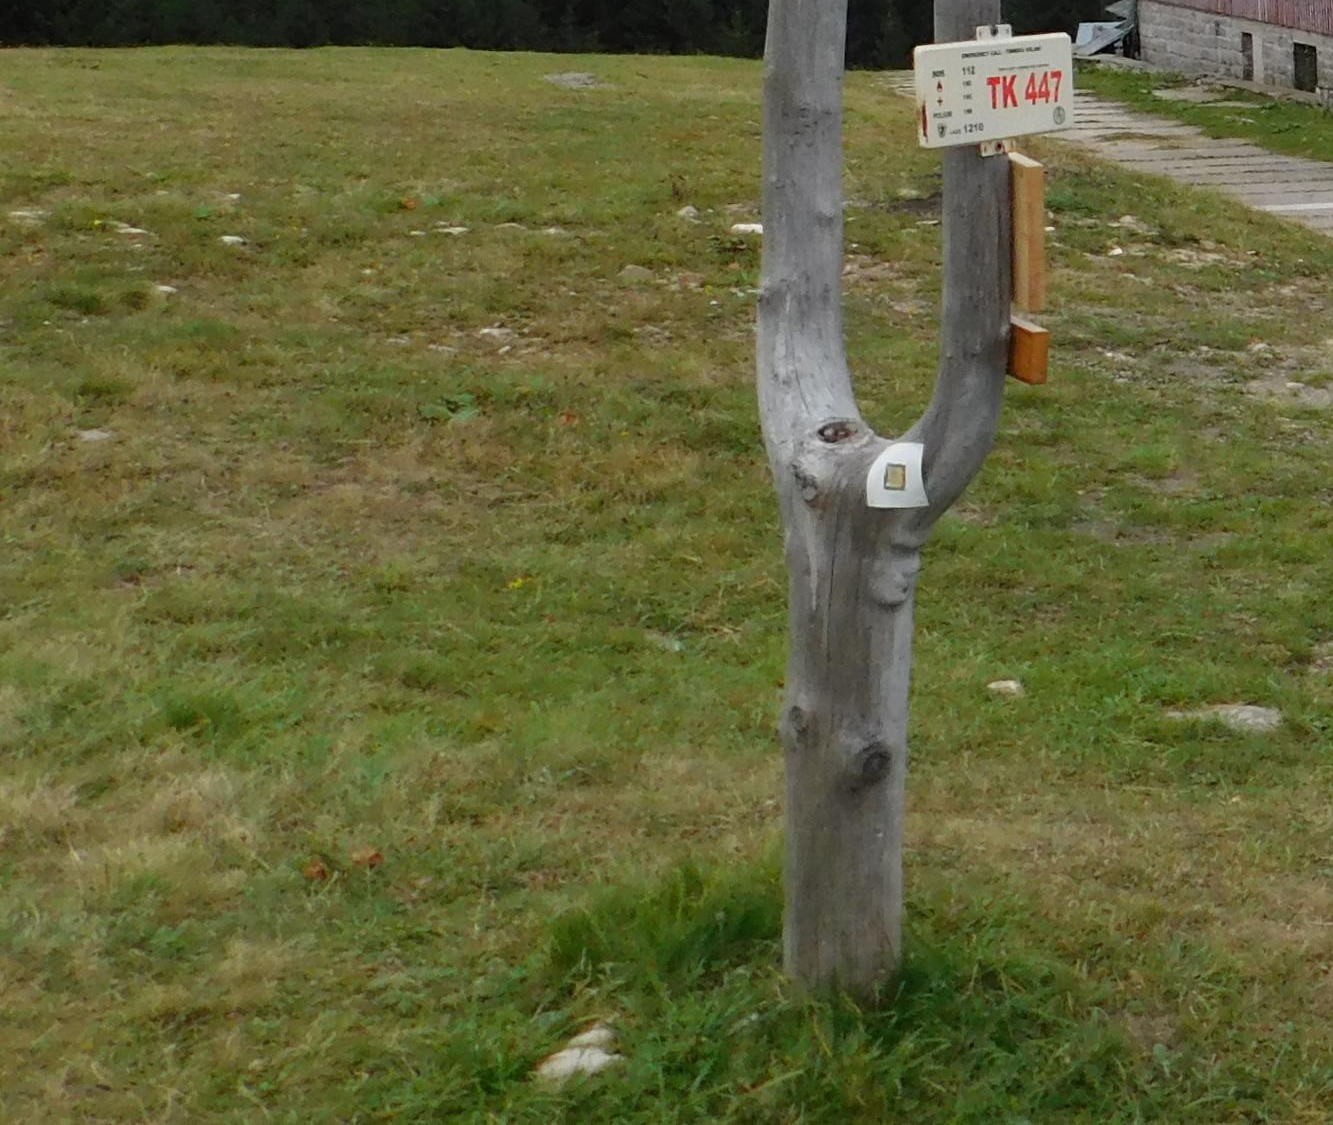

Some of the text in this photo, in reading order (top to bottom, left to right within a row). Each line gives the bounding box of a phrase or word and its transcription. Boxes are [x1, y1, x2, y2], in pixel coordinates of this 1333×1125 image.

[986, 70, 1063, 109] TK 447
[963, 122, 984, 134] 1210
